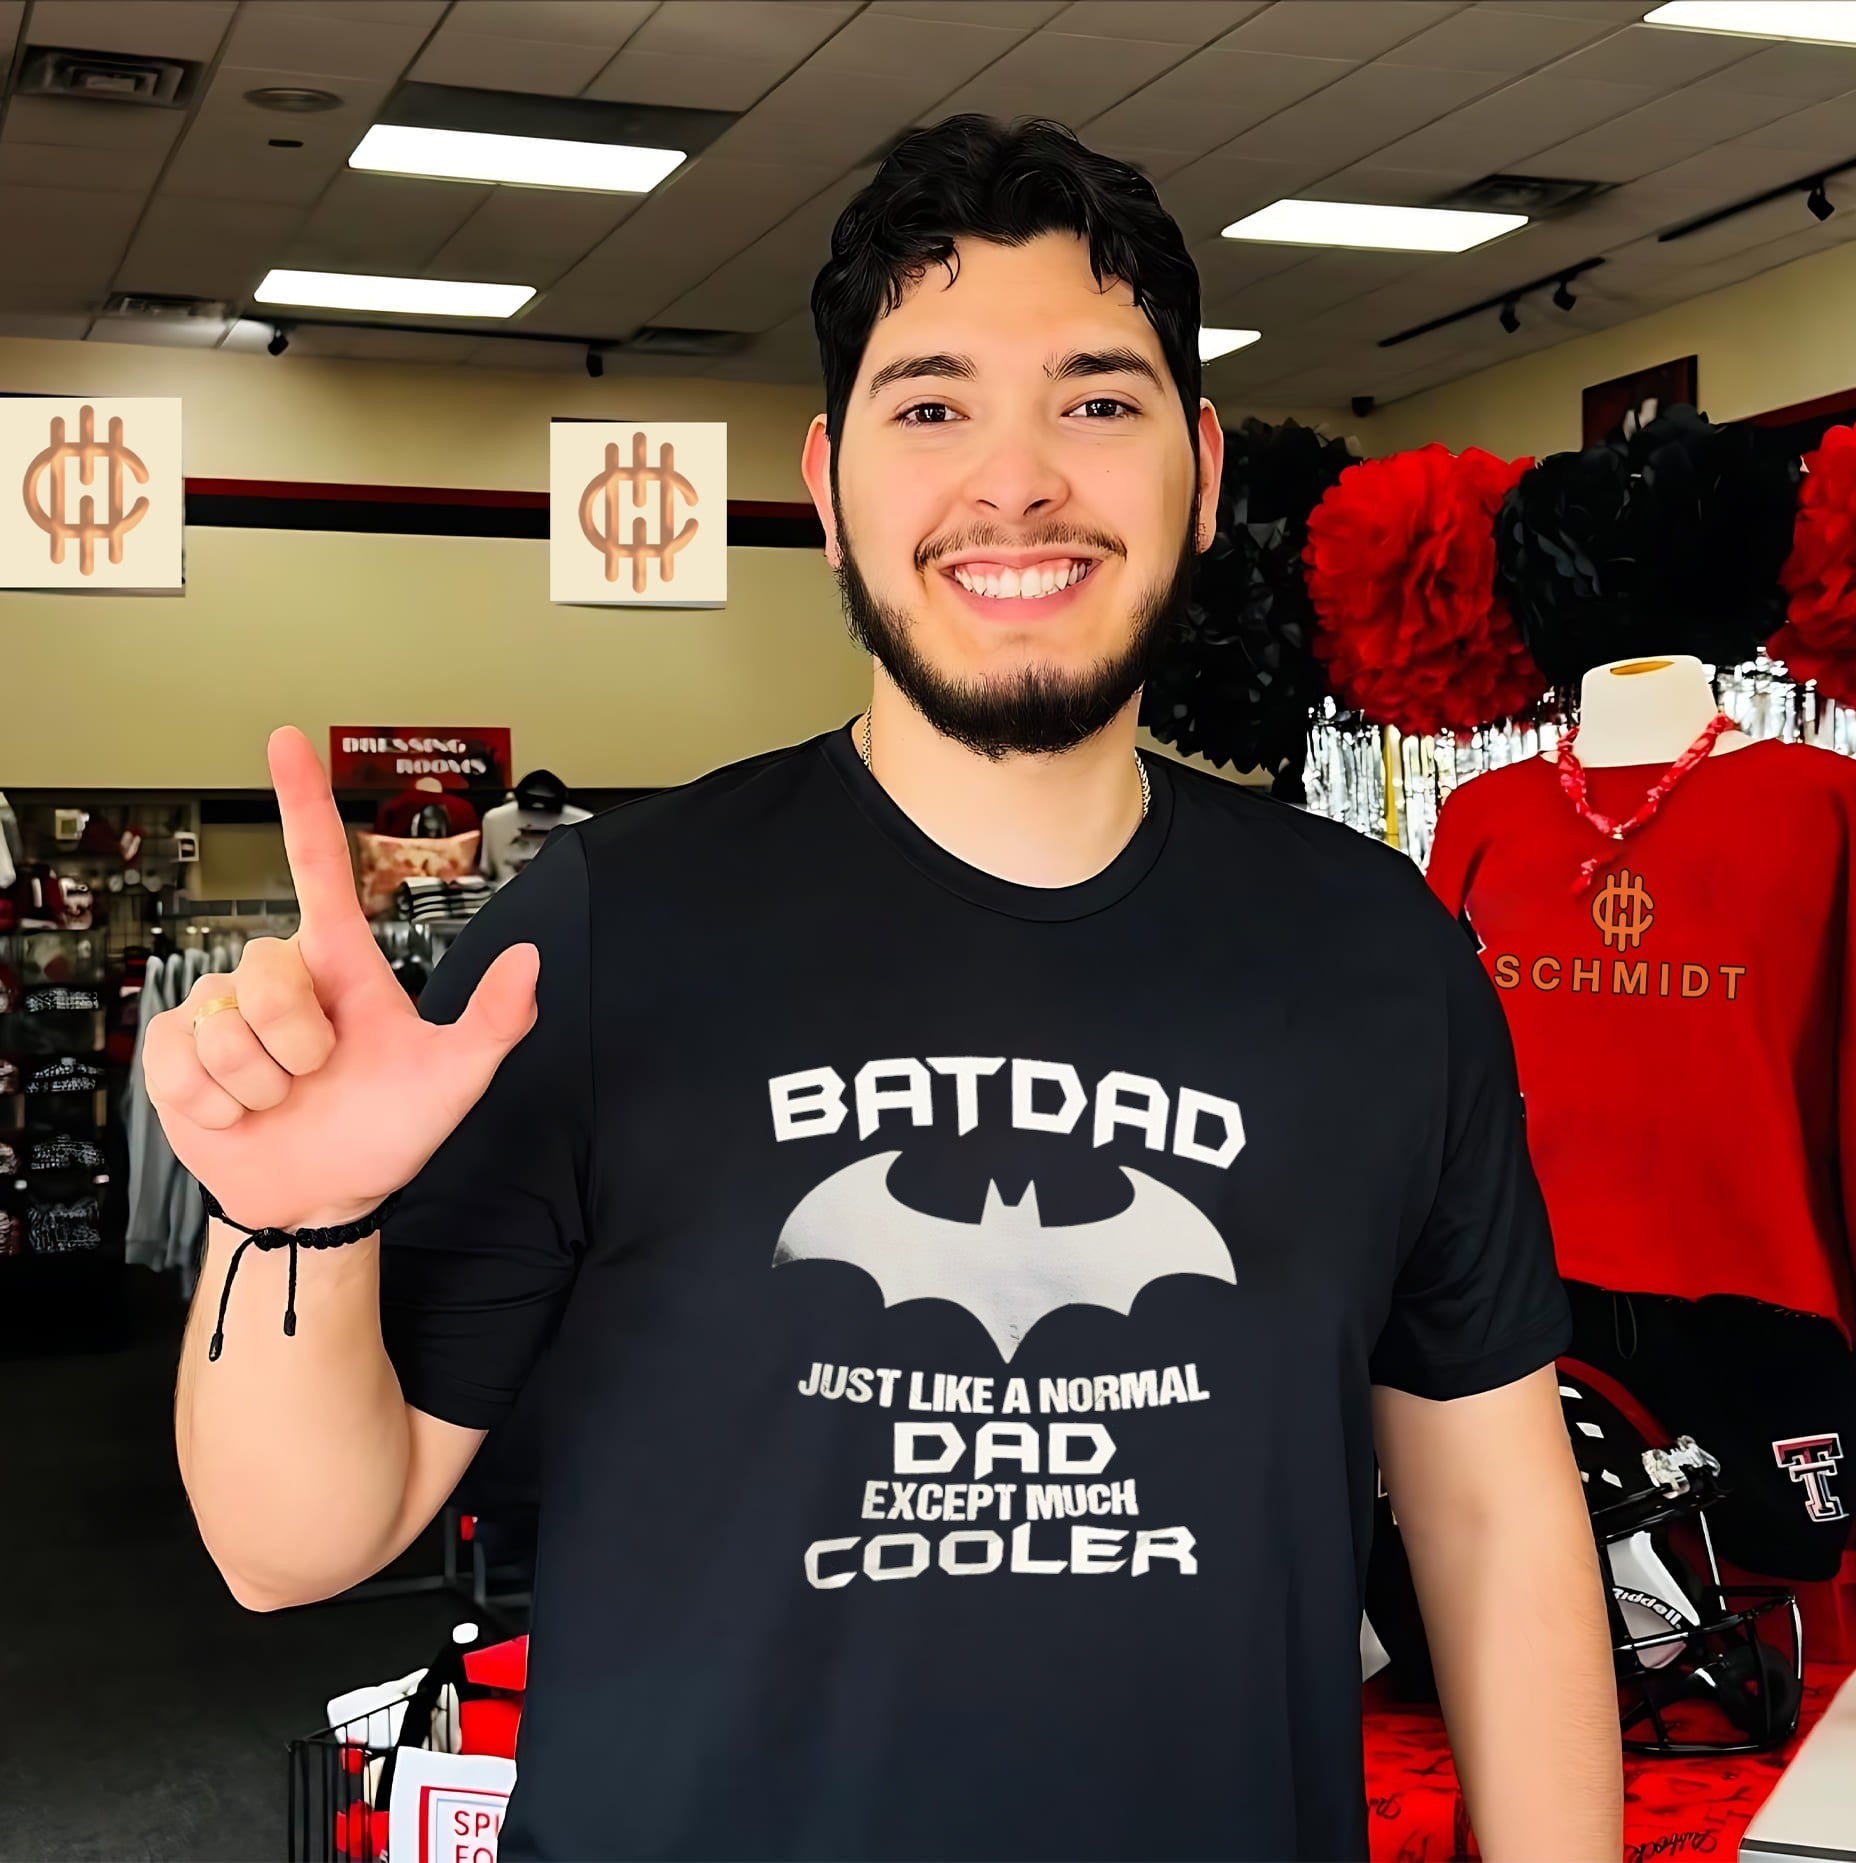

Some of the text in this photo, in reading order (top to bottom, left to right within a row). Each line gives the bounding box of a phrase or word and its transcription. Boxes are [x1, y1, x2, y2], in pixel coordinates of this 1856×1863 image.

[396, 758, 487, 775] ROOMS
[1493, 954, 1747, 1000] SCHMIDT
[769, 1056, 1247, 1169] BATDAD
[798, 1362, 1211, 1414] JUST LIKE A NORMAL
[894, 1421, 1118, 1480] DAD
[861, 1478, 1140, 1521] EXCEPT MUCH
[804, 1521, 1199, 1590] COOLER
